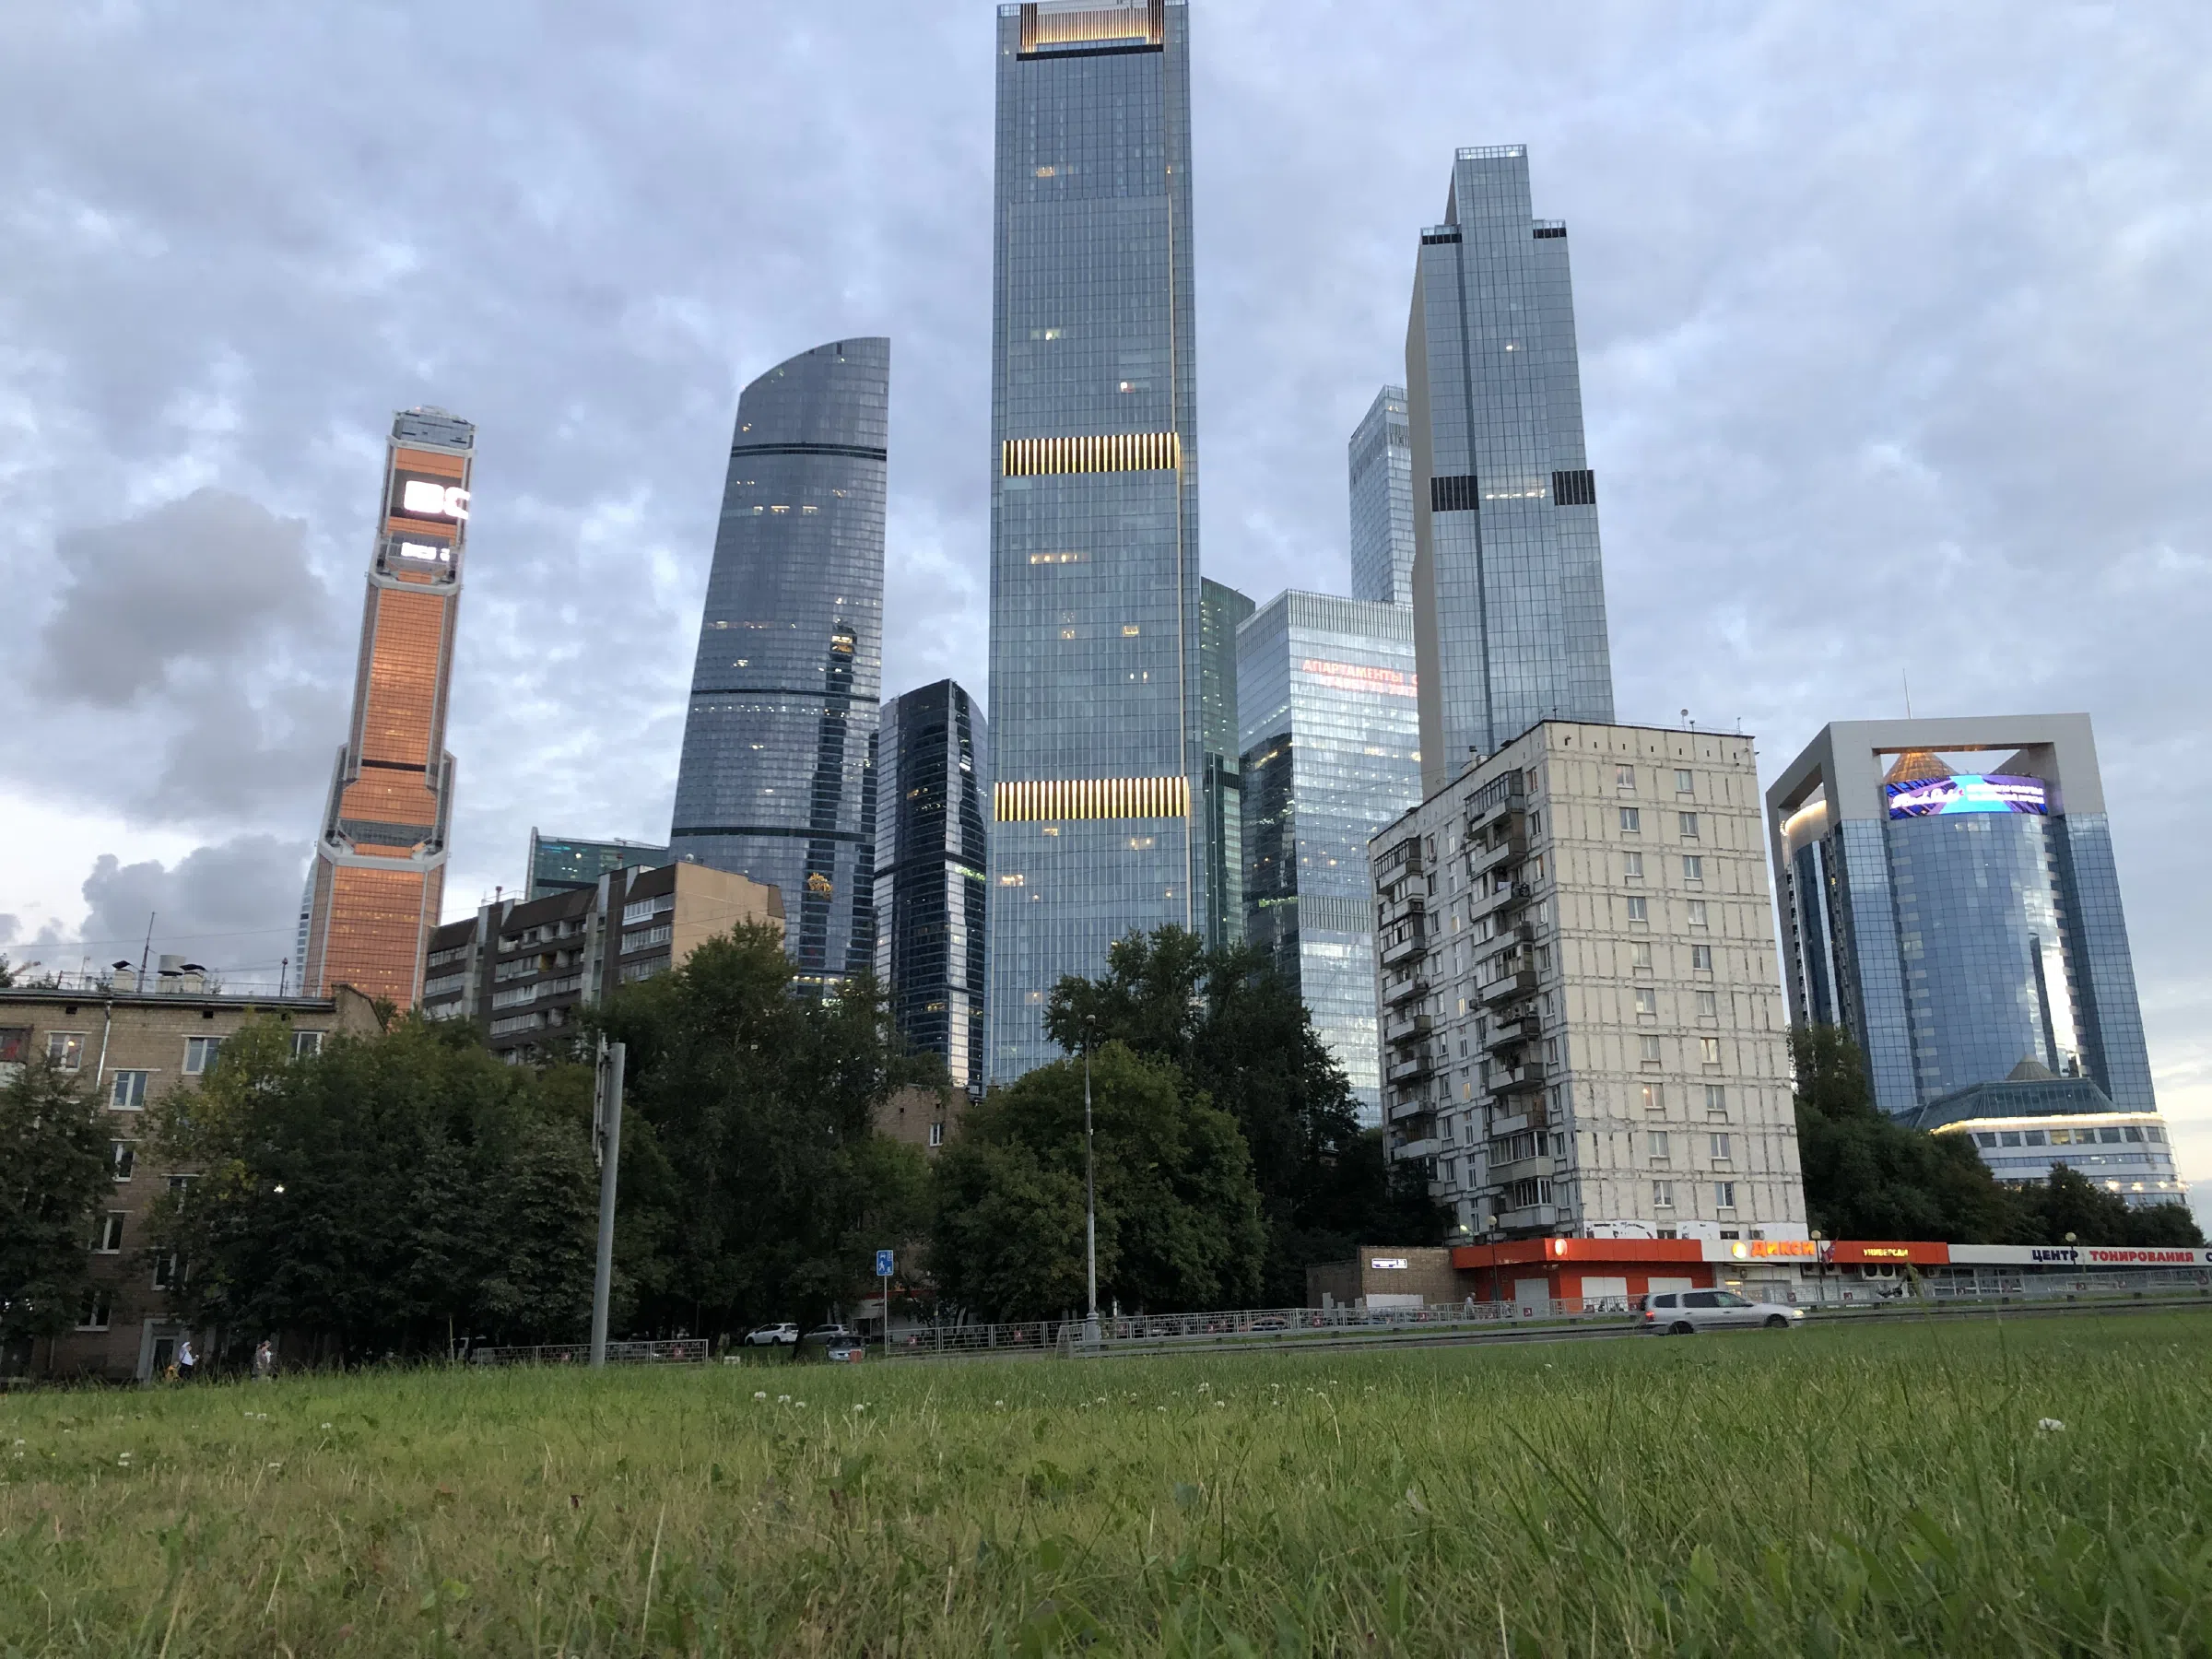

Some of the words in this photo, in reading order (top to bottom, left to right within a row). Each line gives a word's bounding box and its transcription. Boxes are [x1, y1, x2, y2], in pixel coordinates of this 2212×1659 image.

[1302, 659, 1404, 683] АПАРТАМЕНТЫ
[1751, 1241, 1816, 1258] ДИКСИ
[1863, 1248, 1909, 1257] УНИВЕРСАМ
[2032, 1250, 2078, 1262] ЦЕНТР
[2089, 1251, 2194, 1262] ТОНИРОВАНИЯ
